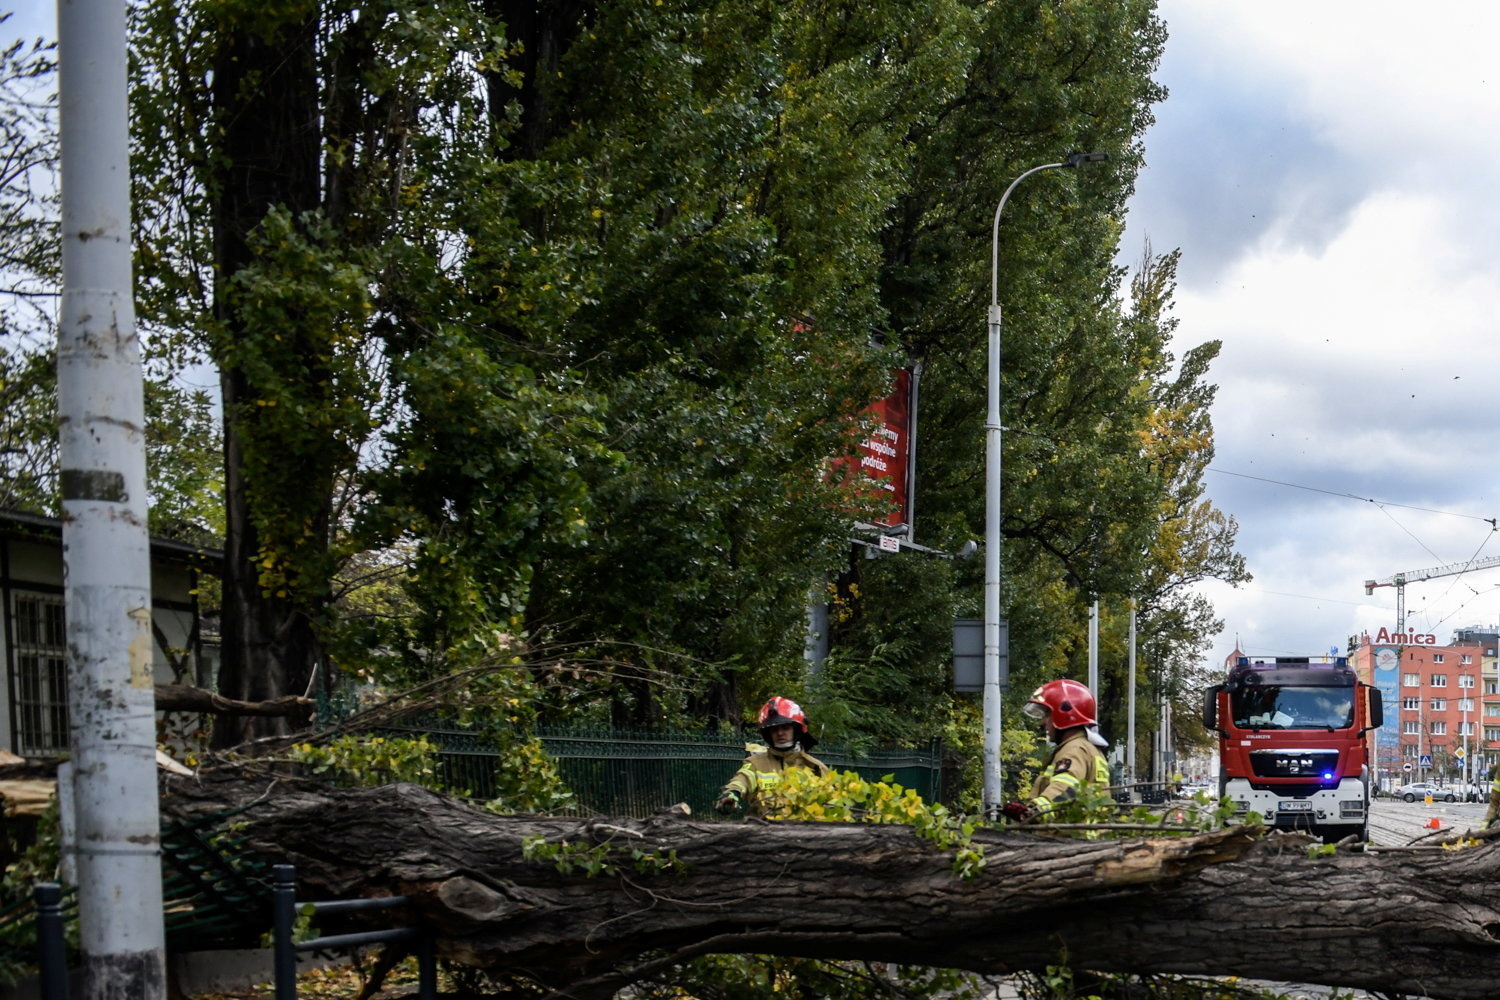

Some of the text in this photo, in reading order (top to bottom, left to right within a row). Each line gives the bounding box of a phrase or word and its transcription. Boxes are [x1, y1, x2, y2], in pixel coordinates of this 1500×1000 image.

[870, 441, 896, 457] wspólne
[861, 455, 887, 471] podróże
[1376, 627, 1436, 644] Amica
[1276, 759, 1313, 767] MAN
